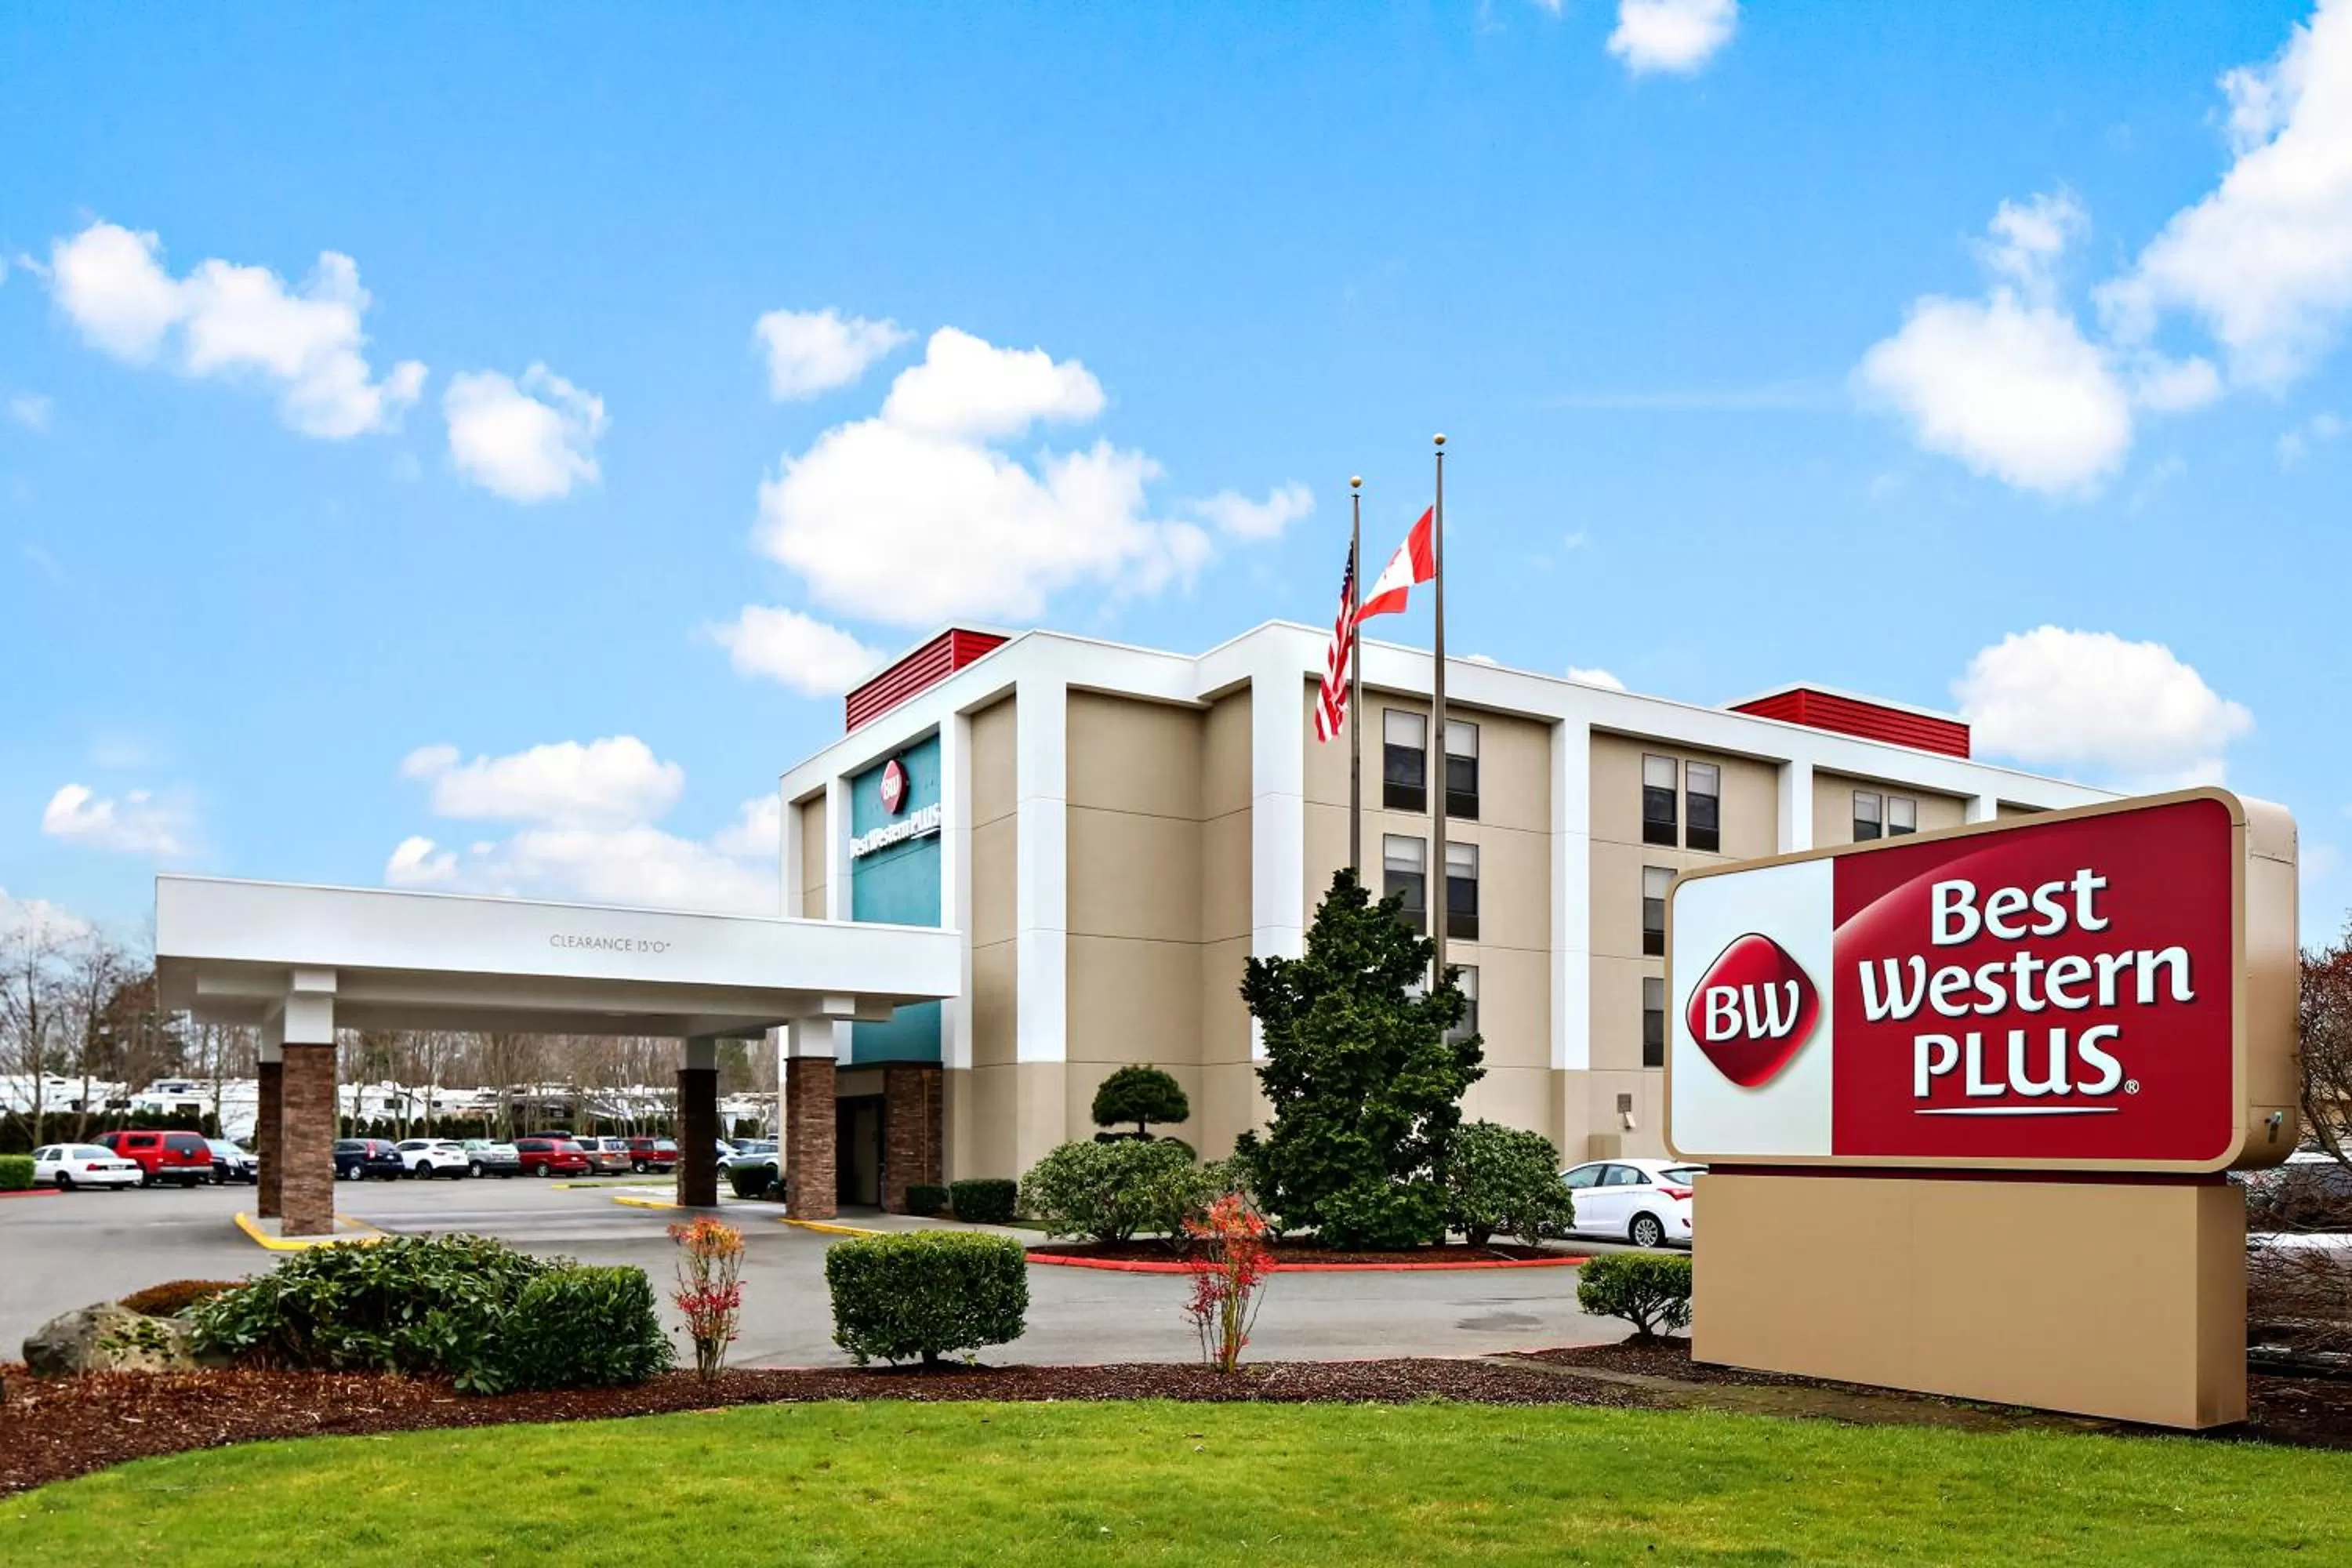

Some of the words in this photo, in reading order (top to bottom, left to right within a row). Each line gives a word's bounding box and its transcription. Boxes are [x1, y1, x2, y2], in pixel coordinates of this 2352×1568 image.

[550, 934, 632, 951] CLEARANCE
[1931, 868, 2108, 946] Best
[1705, 979, 1800, 1041] BW
[1858, 946, 2195, 1022] Western
[1913, 1024, 2122, 1097] PLUS
